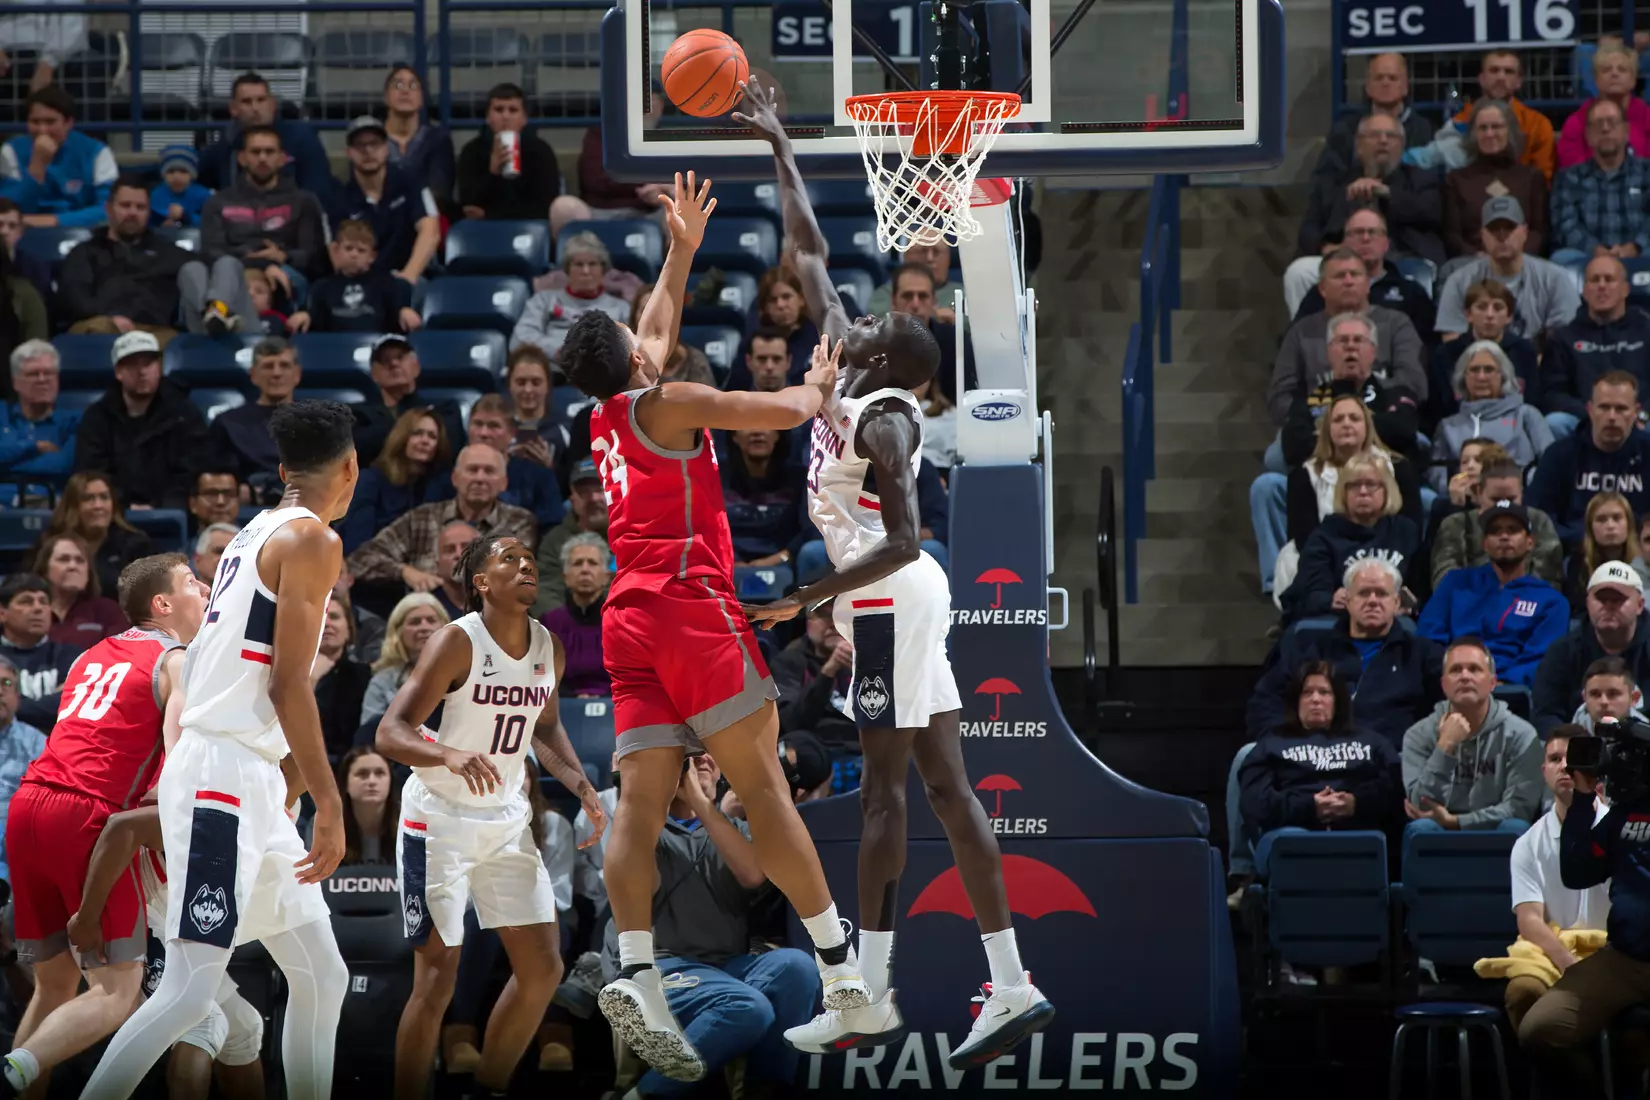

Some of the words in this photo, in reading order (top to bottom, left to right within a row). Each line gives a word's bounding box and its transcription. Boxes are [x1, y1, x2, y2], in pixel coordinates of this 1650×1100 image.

[777, 16, 834, 46] SE
[1348, 6, 1425, 37] SEC
[1464, 0, 1575, 43] 116
[1575, 471, 1643, 493] UCONN
[949, 609, 1047, 625] TRAVELERS
[57, 662, 132, 723] 30
[472, 683, 550, 707] UCONN
[489, 713, 528, 755] 10
[989, 818, 1048, 834] ELERS
[329, 877, 400, 893] UCONN
